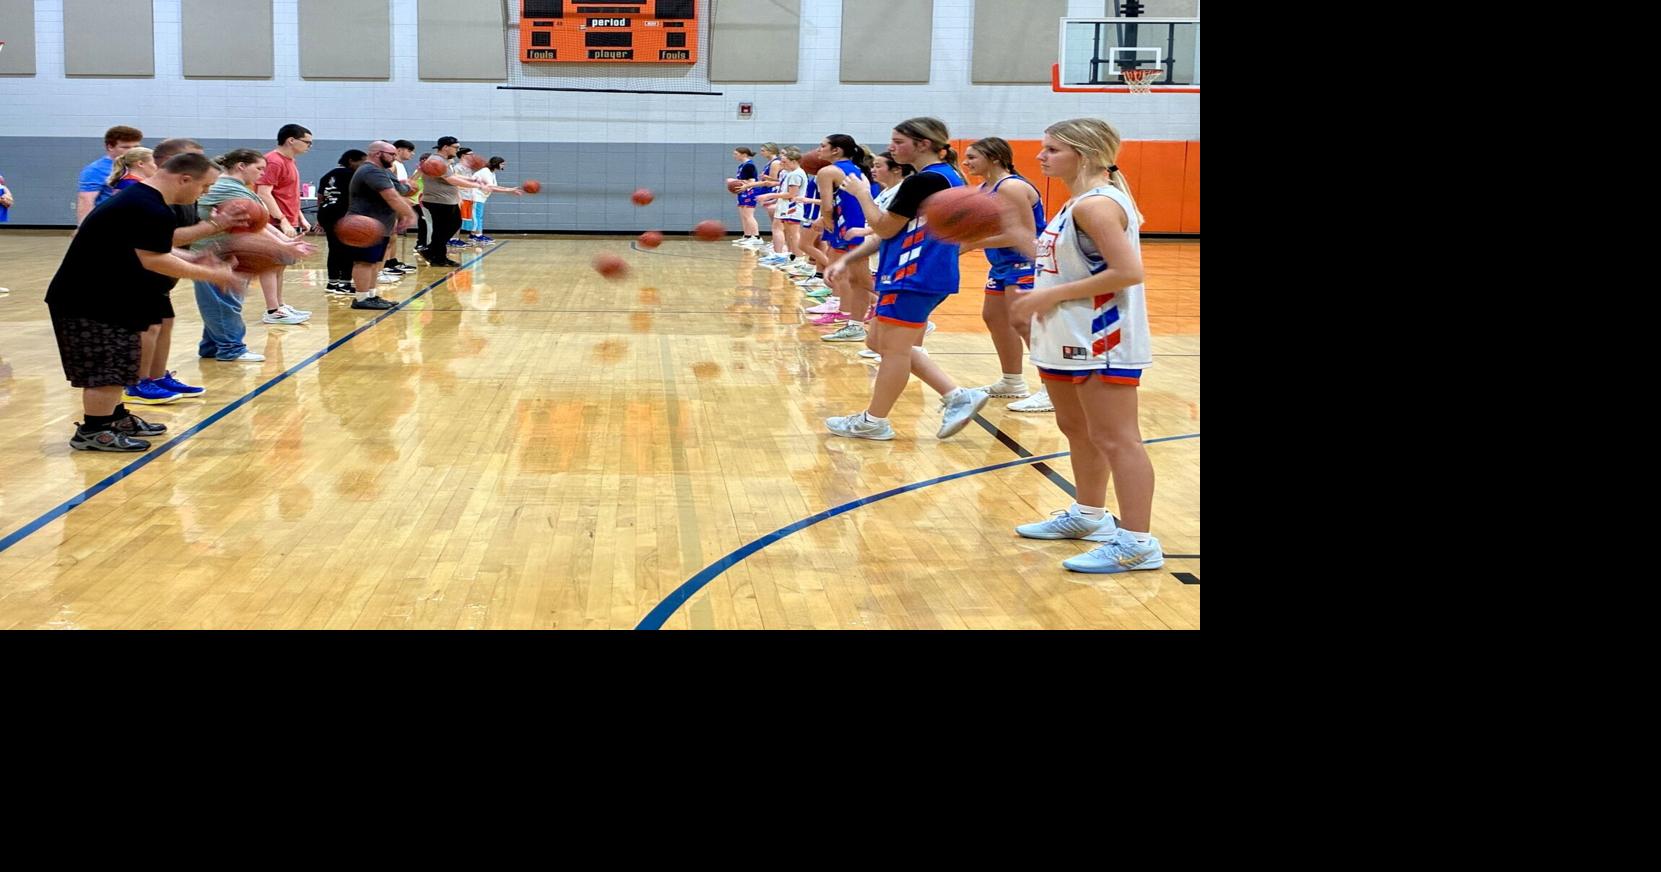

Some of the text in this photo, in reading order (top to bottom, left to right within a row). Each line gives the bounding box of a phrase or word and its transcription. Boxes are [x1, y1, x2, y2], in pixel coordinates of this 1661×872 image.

[591, 18, 626, 27] period
[529, 49, 554, 59] fouls
[594, 49, 628, 59] player
[661, 51, 686, 60] fouls
